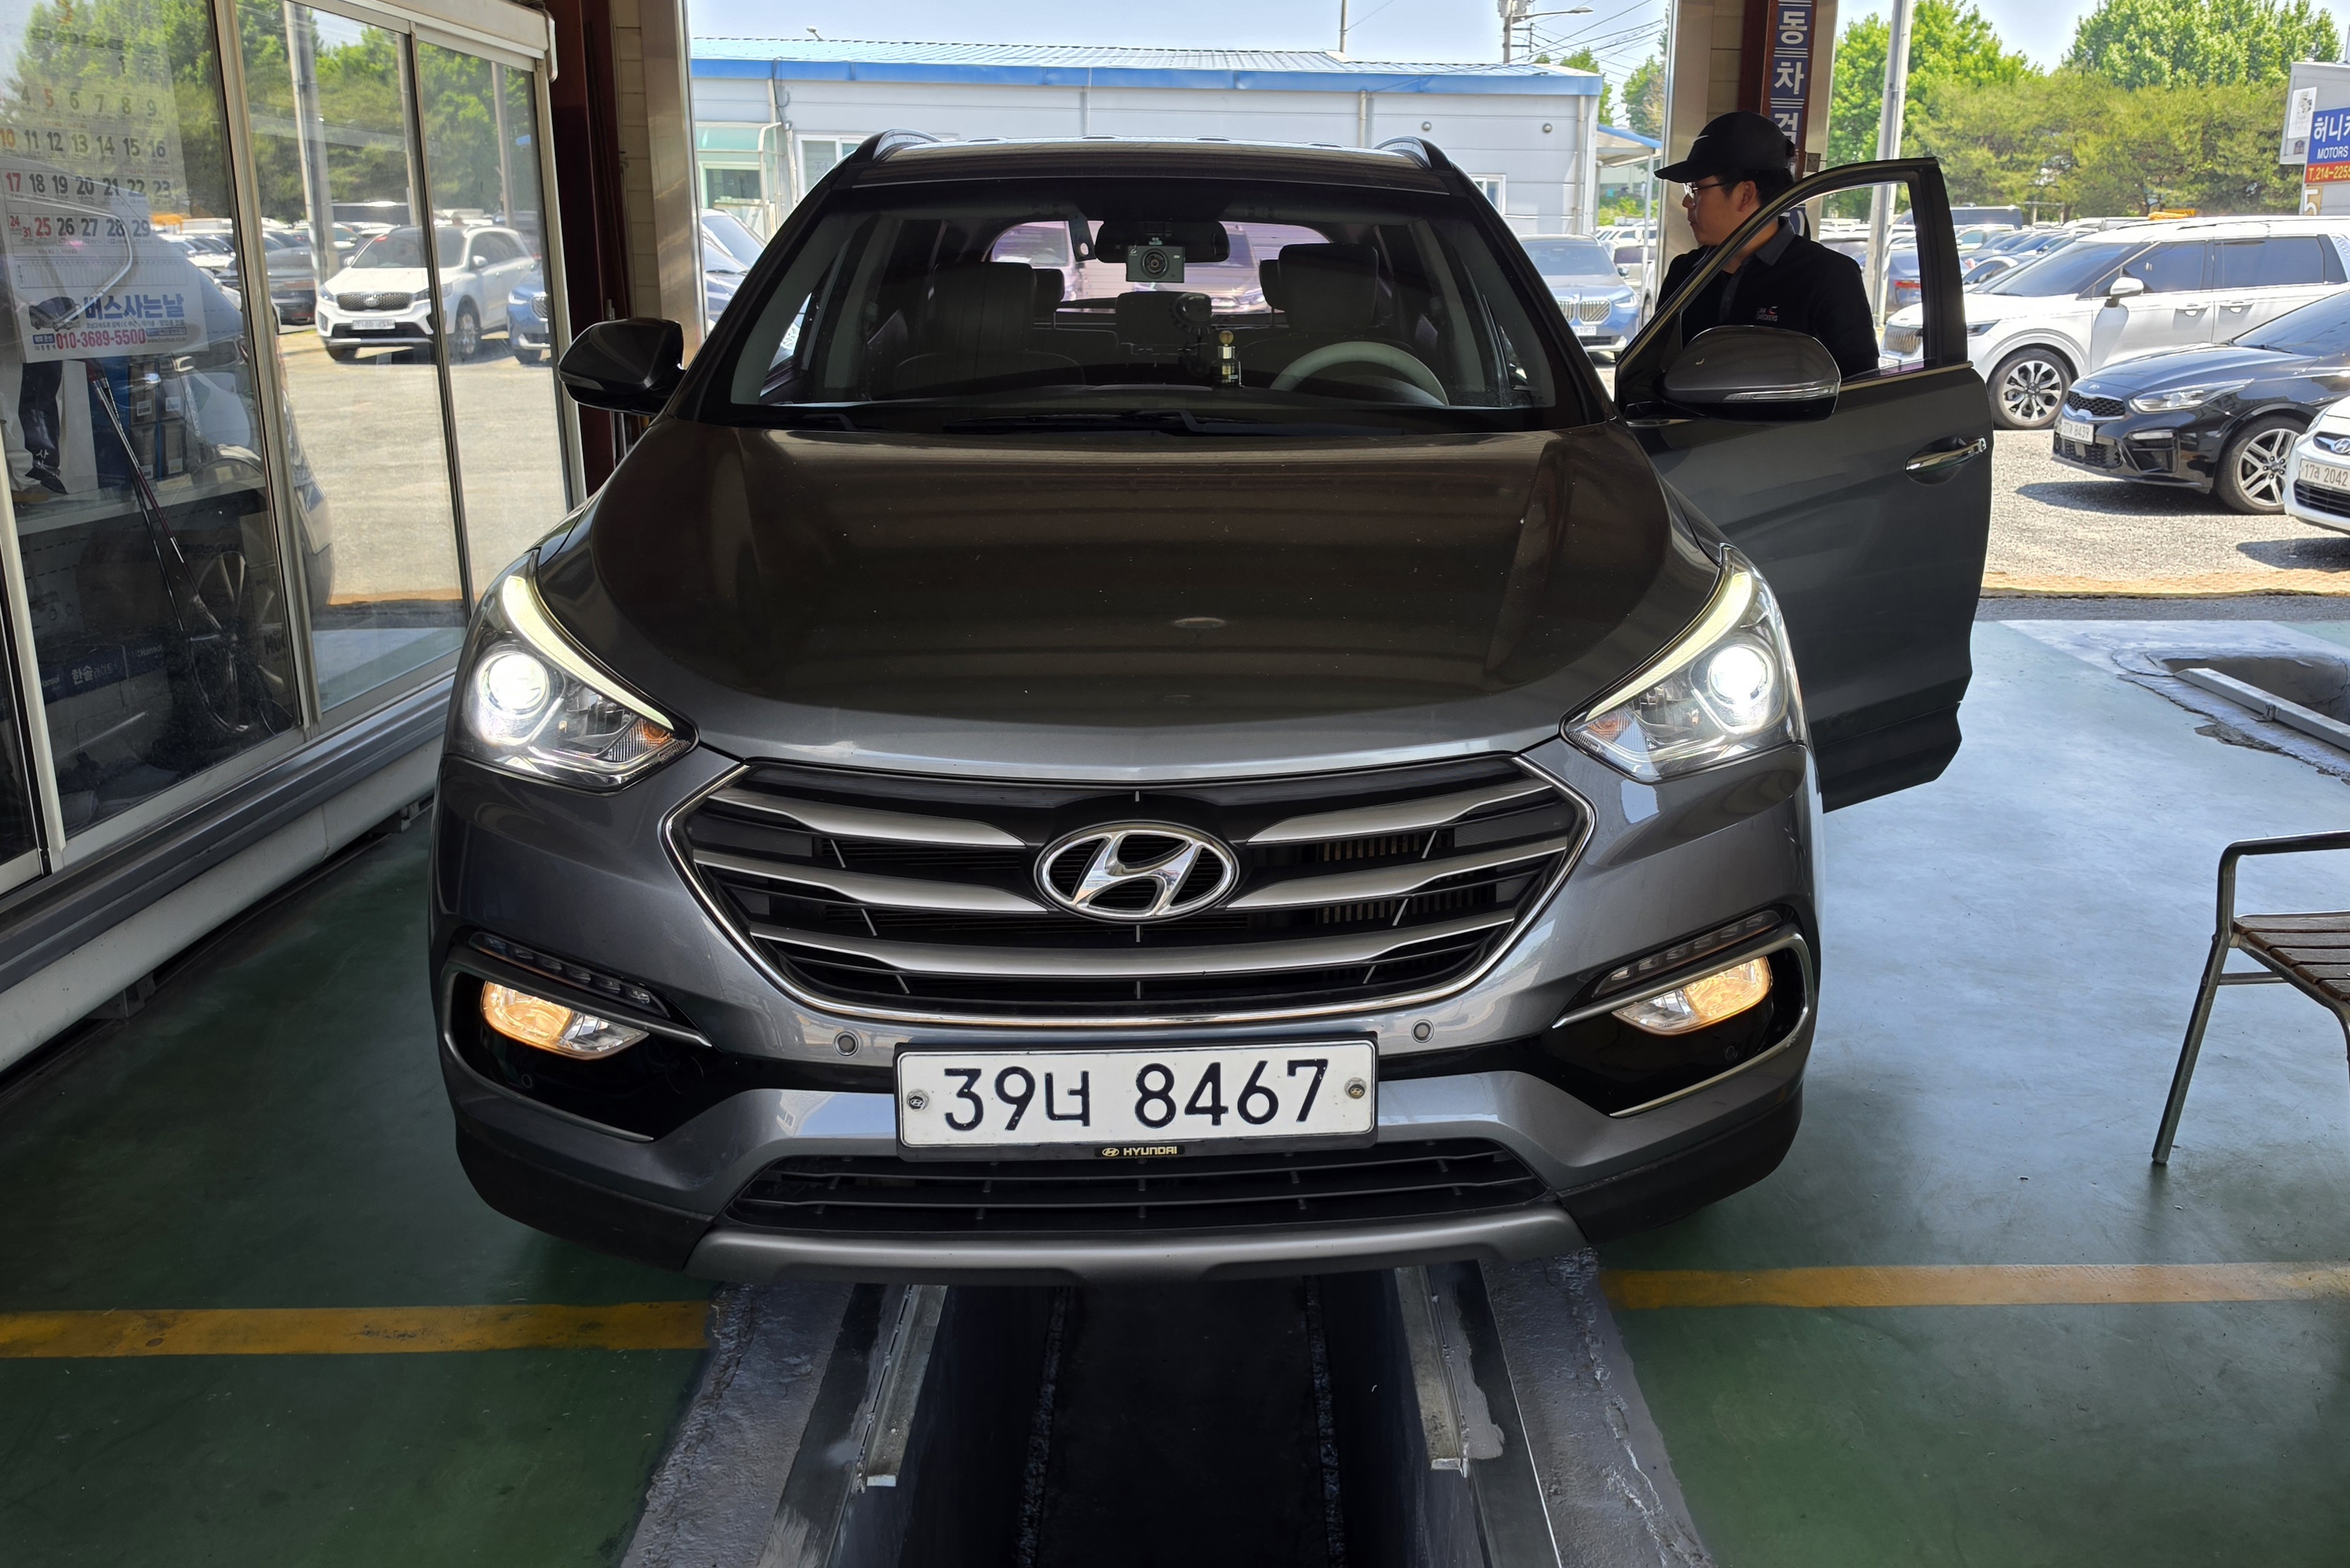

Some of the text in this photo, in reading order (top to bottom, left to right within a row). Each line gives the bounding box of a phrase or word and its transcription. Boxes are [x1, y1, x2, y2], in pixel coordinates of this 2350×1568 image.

[21, 86, 31, 105] 4
[44, 89, 54, 108] 5
[70, 91, 80, 110] 6
[95, 94, 105, 112] 7
[121, 96, 131, 114] 8
[147, 98, 157, 117] 9
[24, 130, 38, 149] 11
[47, 131, 63, 151] 12
[71, 133, 89, 153] 13
[96, 135, 114, 155] 14
[123, 138, 140, 156] 15
[148, 140, 166, 158] 16
[2317, 145, 2349, 159] MOTORS
[6, 172, 171, 198] 17 18 19 20 21 22 23
[2304, 188, 2319, 215] 5
[10, 215, 20, 227] 24
[22, 217, 152, 237] 31 25 26 27 28 29
[84, 293, 185, 320] 버스사는날
[56, 327, 146, 349] 010-3689-5500
[2323, 467, 2349, 487] 2042
[944, 1058, 1329, 1132] 39너 8467
[1123, 1146, 1178, 1156] HYUNDAI
